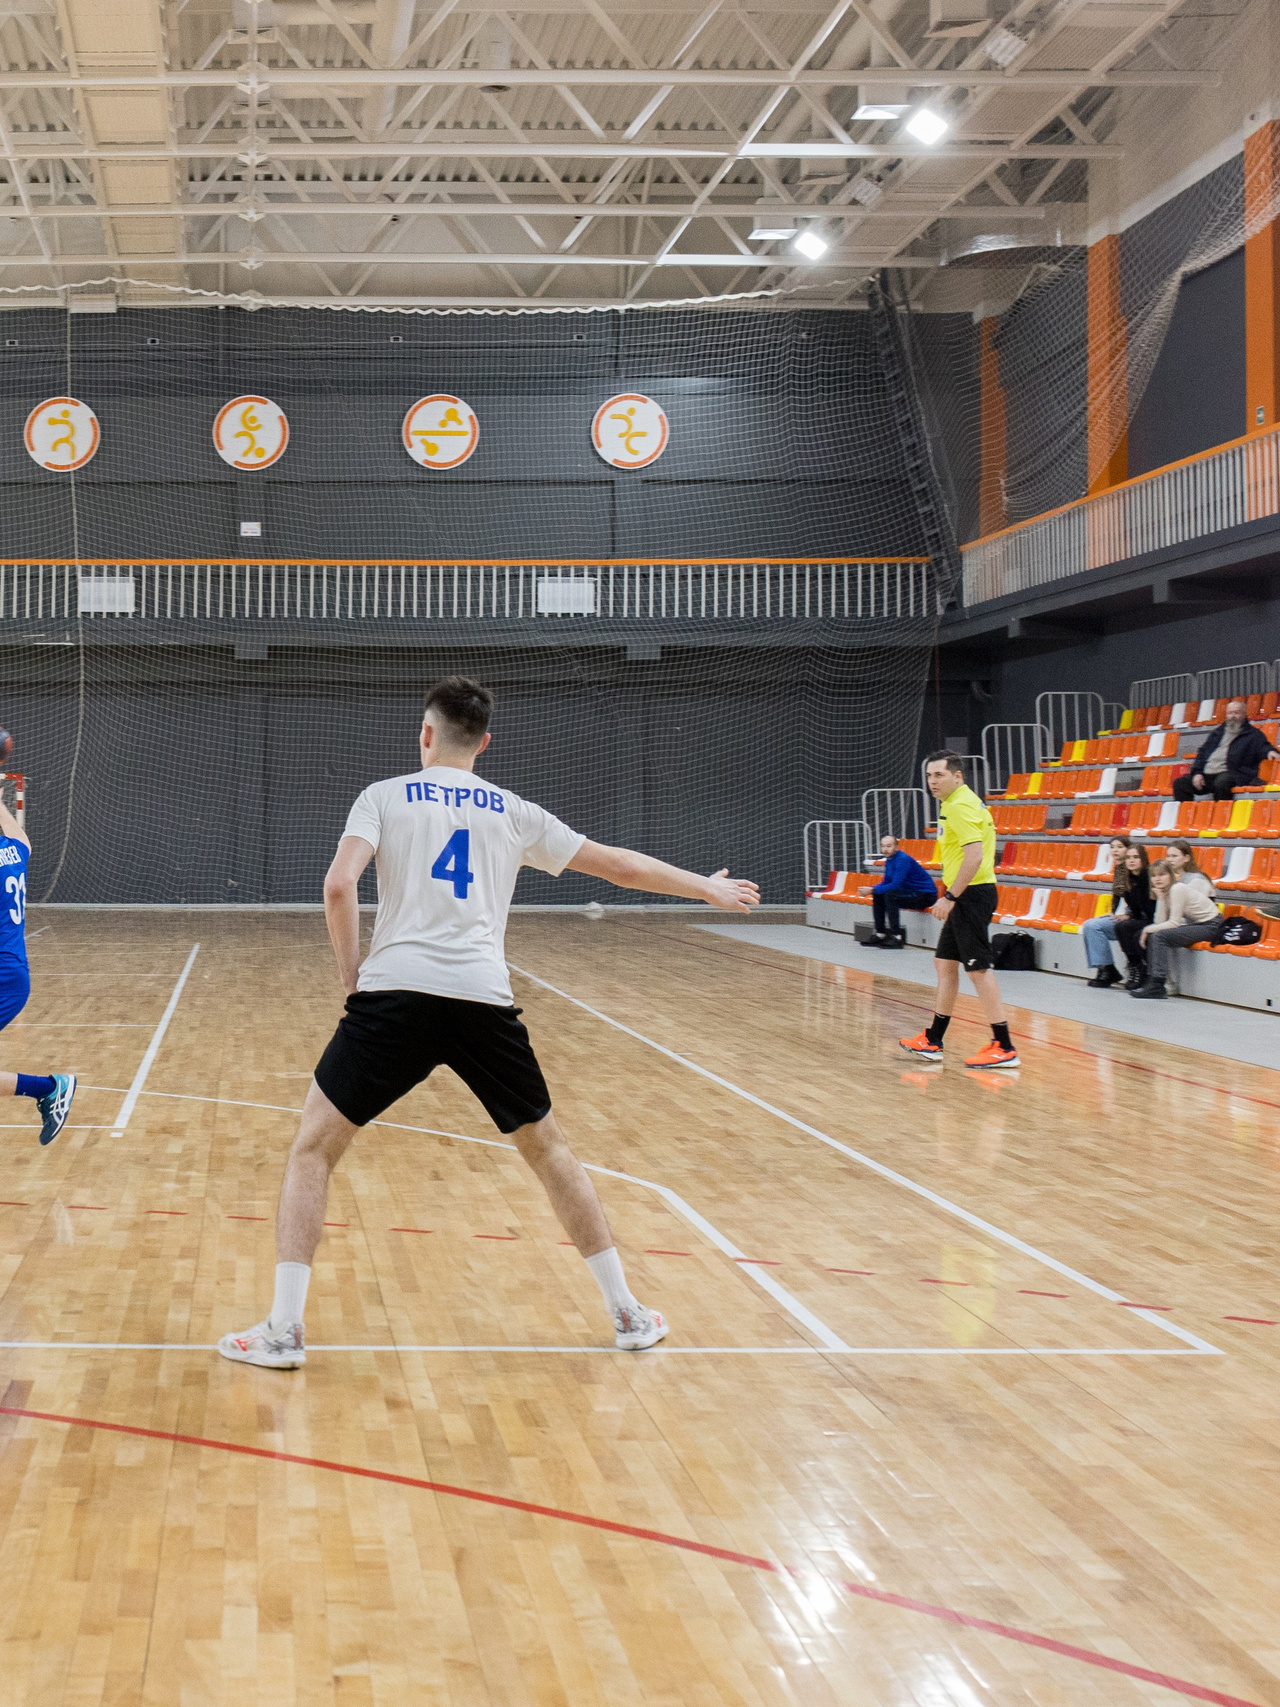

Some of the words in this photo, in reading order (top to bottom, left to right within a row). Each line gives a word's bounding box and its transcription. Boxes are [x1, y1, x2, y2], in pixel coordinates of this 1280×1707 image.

[405, 782, 505, 814] ПЕТРОВ
[431, 829, 474, 899] 4
[5, 872, 26, 925] 31
